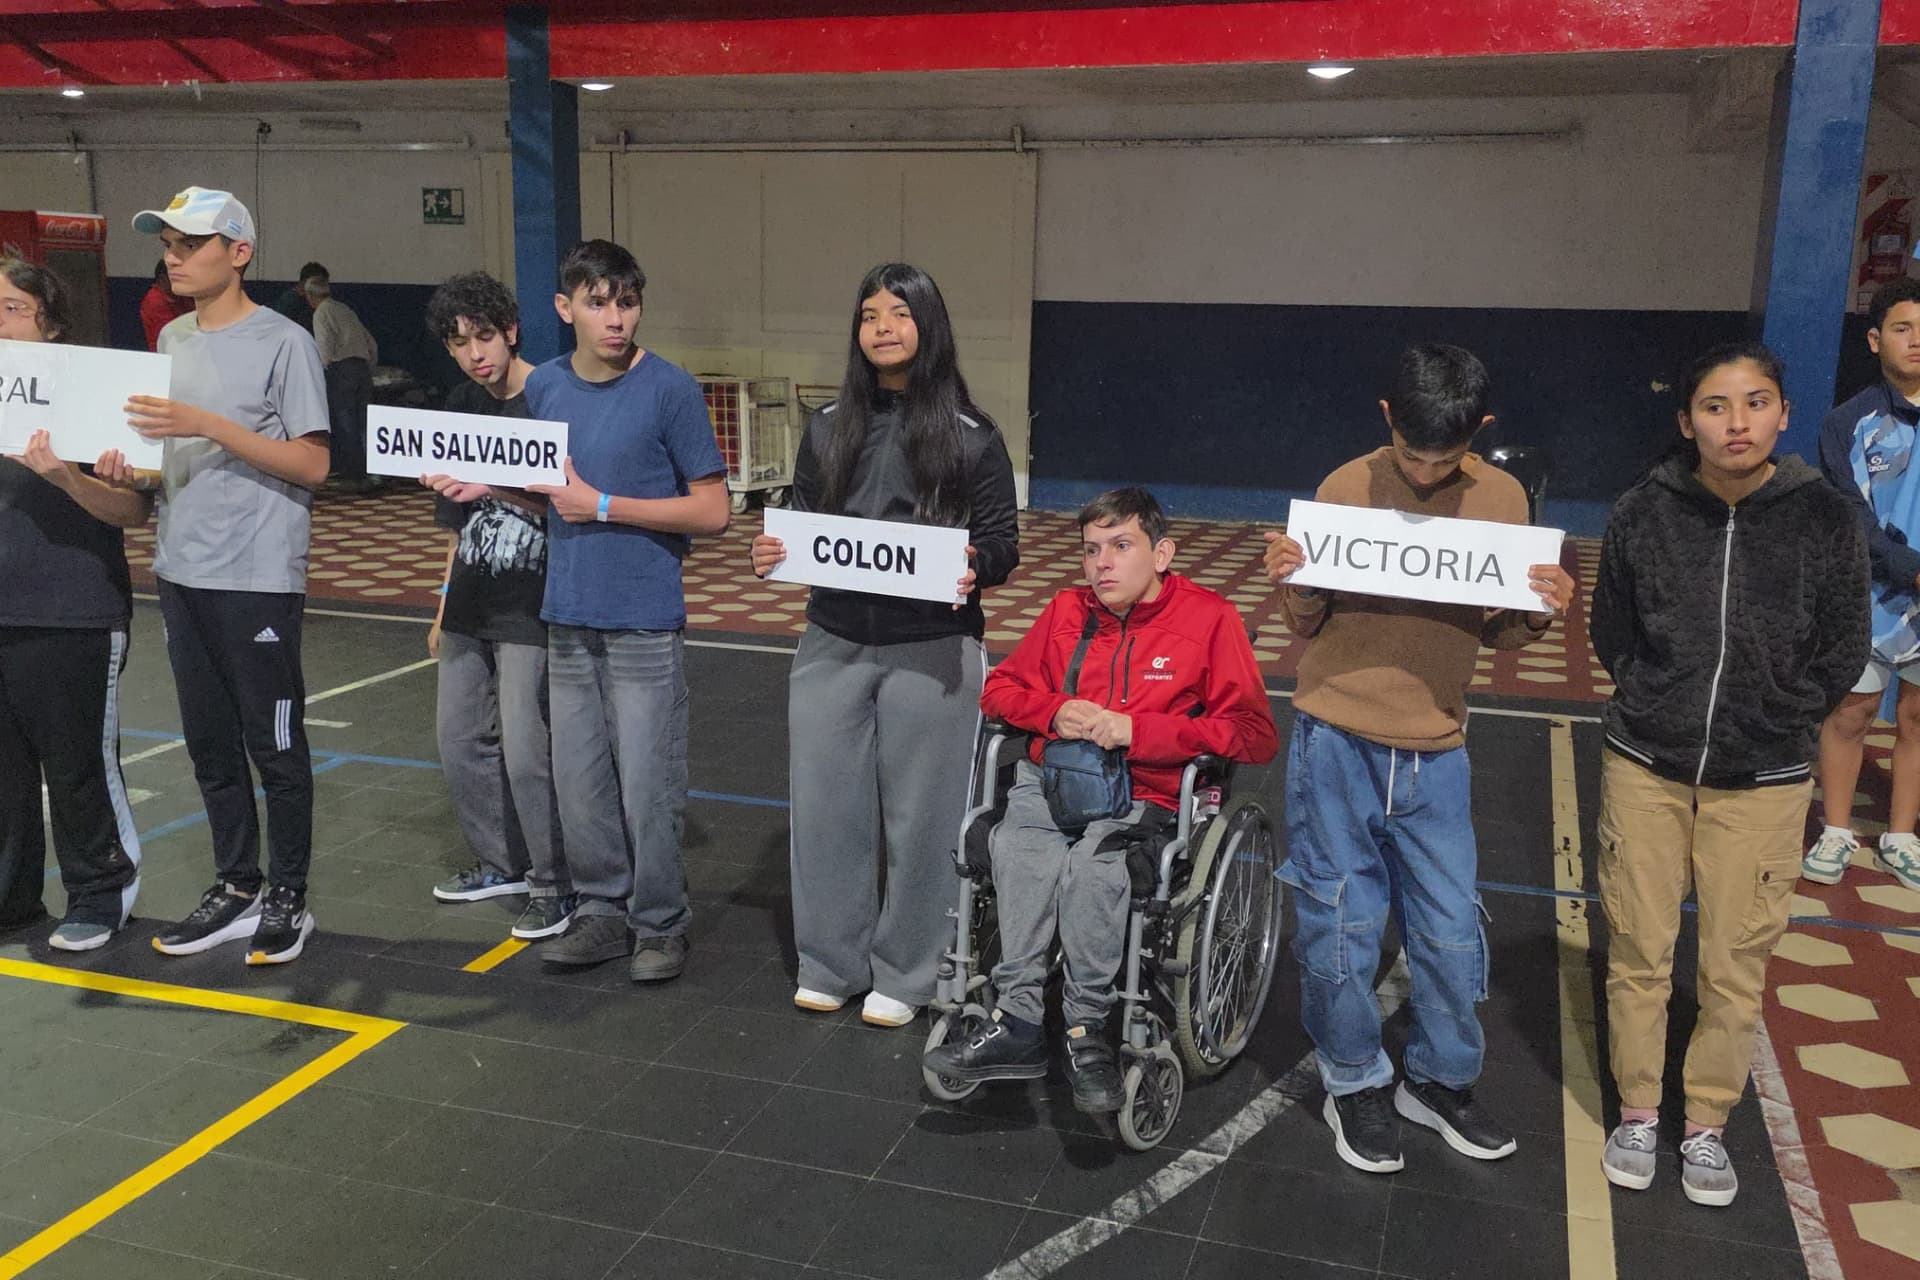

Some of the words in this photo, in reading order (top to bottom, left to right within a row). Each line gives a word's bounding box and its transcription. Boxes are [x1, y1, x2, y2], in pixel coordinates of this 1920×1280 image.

[0, 376, 50, 406] AL
[376, 426, 423, 458] SAN
[431, 431, 558, 469] SALVADOR
[813, 535, 916, 575] COLON
[1303, 531, 1505, 587] VICTORIA
